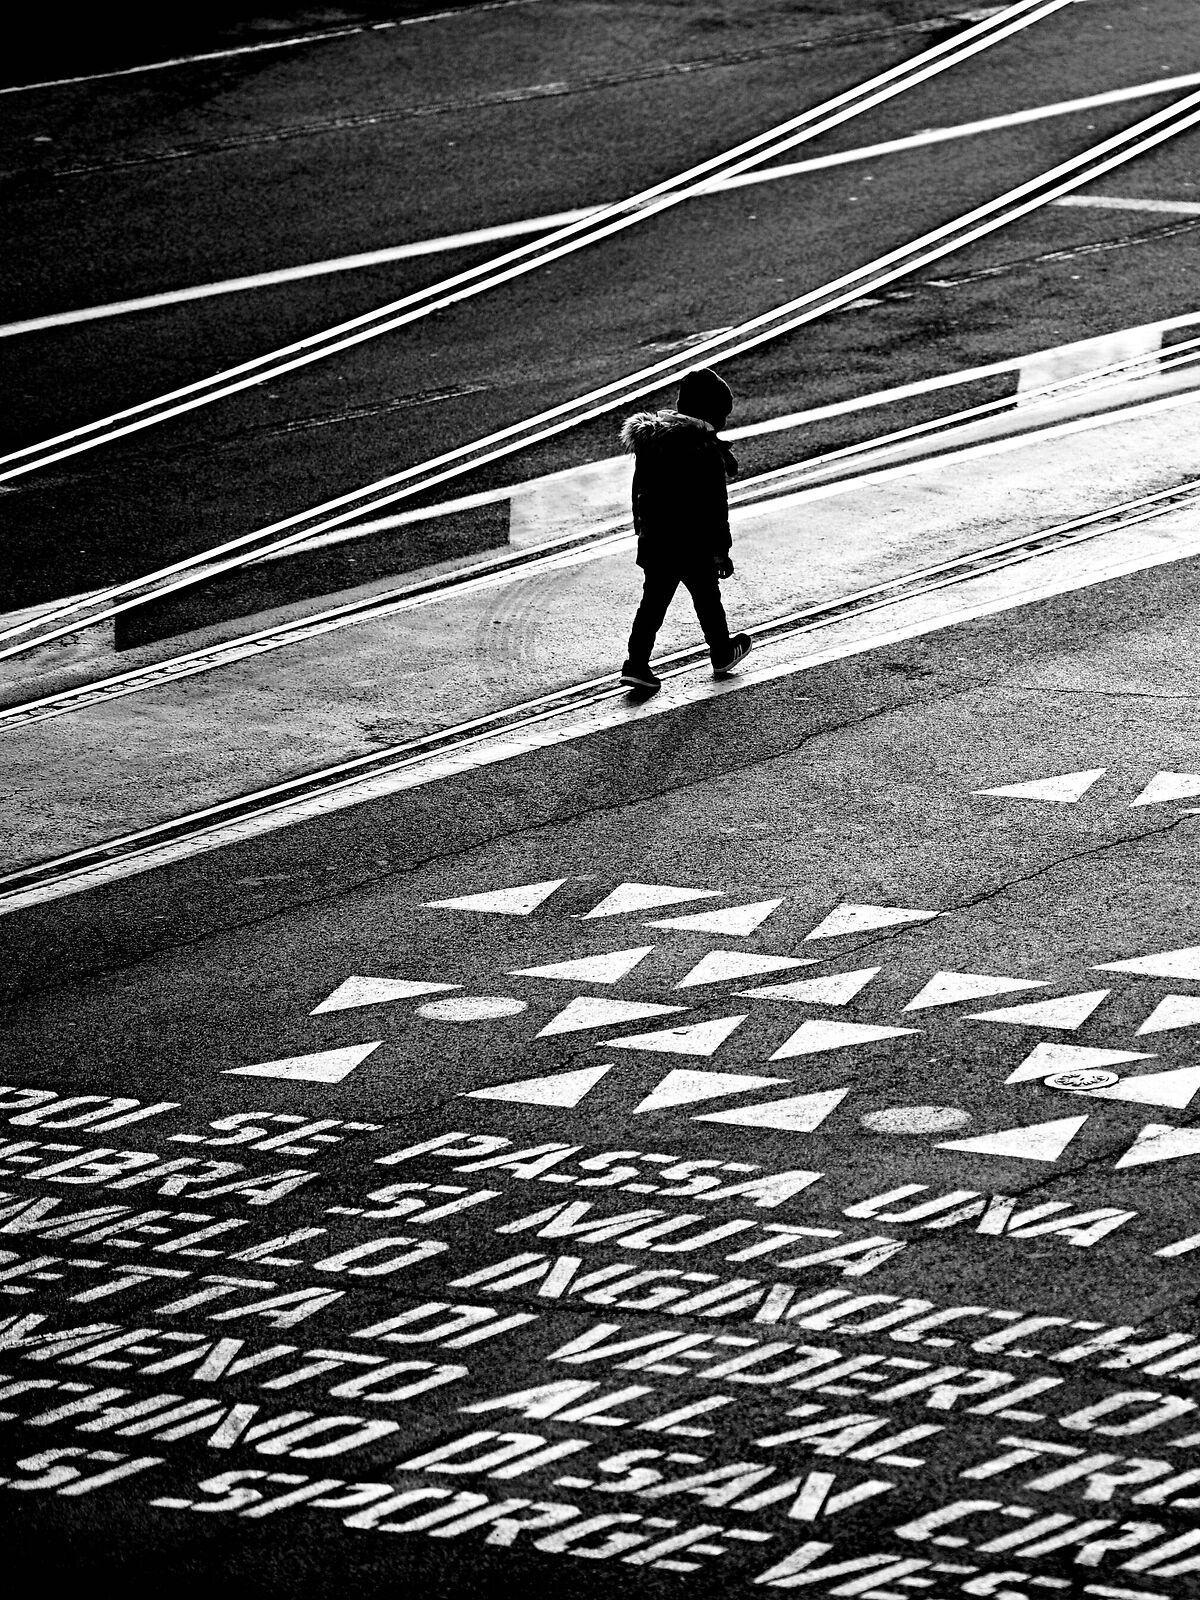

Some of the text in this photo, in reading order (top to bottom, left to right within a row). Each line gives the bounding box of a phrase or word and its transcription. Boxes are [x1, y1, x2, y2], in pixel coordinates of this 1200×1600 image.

[0, 1139, 908, 1277] EBRA SI MUTA
[0, 1193, 449, 1277] MELLO
[166, 1112, 384, 1155] SE
[375, 1131, 825, 1207] PASSA
[842, 1183, 1138, 1248] UNA
[0, 1251, 346, 1328] ETTA
[350, 1302, 540, 1348] DI
[546, 1323, 1199, 1436] VEDERLO
[0, 1376, 400, 1458] CHINO
[397, 1430, 592, 1479] DI
[553, 1449, 897, 1521] SAN
[0, 1447, 166, 1496] SI
[150, 1470, 773, 1571] SPORGE
